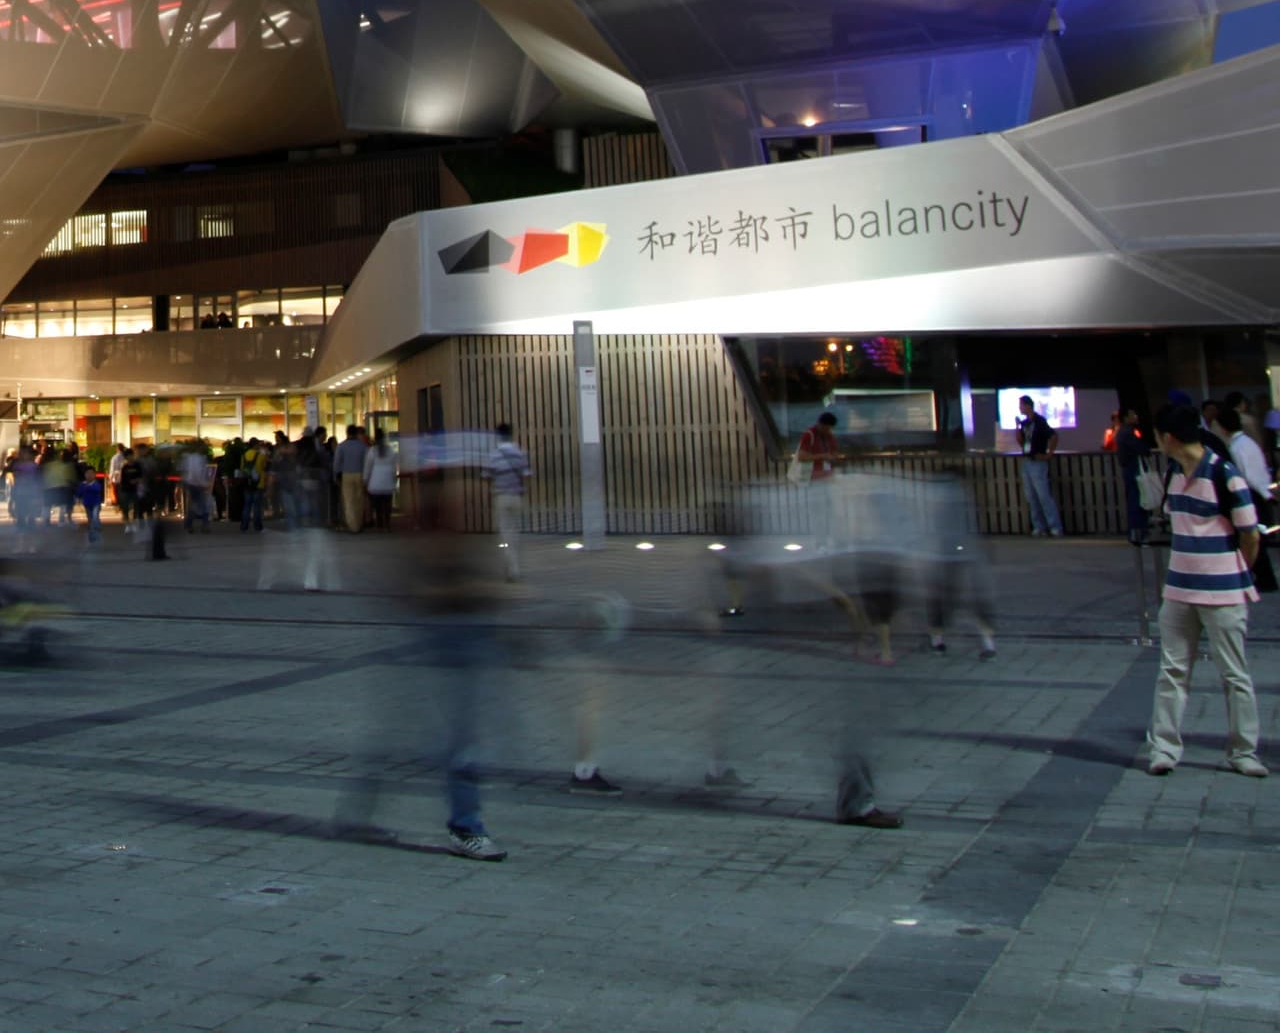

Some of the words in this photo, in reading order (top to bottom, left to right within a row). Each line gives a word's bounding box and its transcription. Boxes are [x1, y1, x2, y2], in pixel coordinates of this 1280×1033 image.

[637, 207, 813, 261] 和谐都市
[833, 190, 1029, 241] balancity
